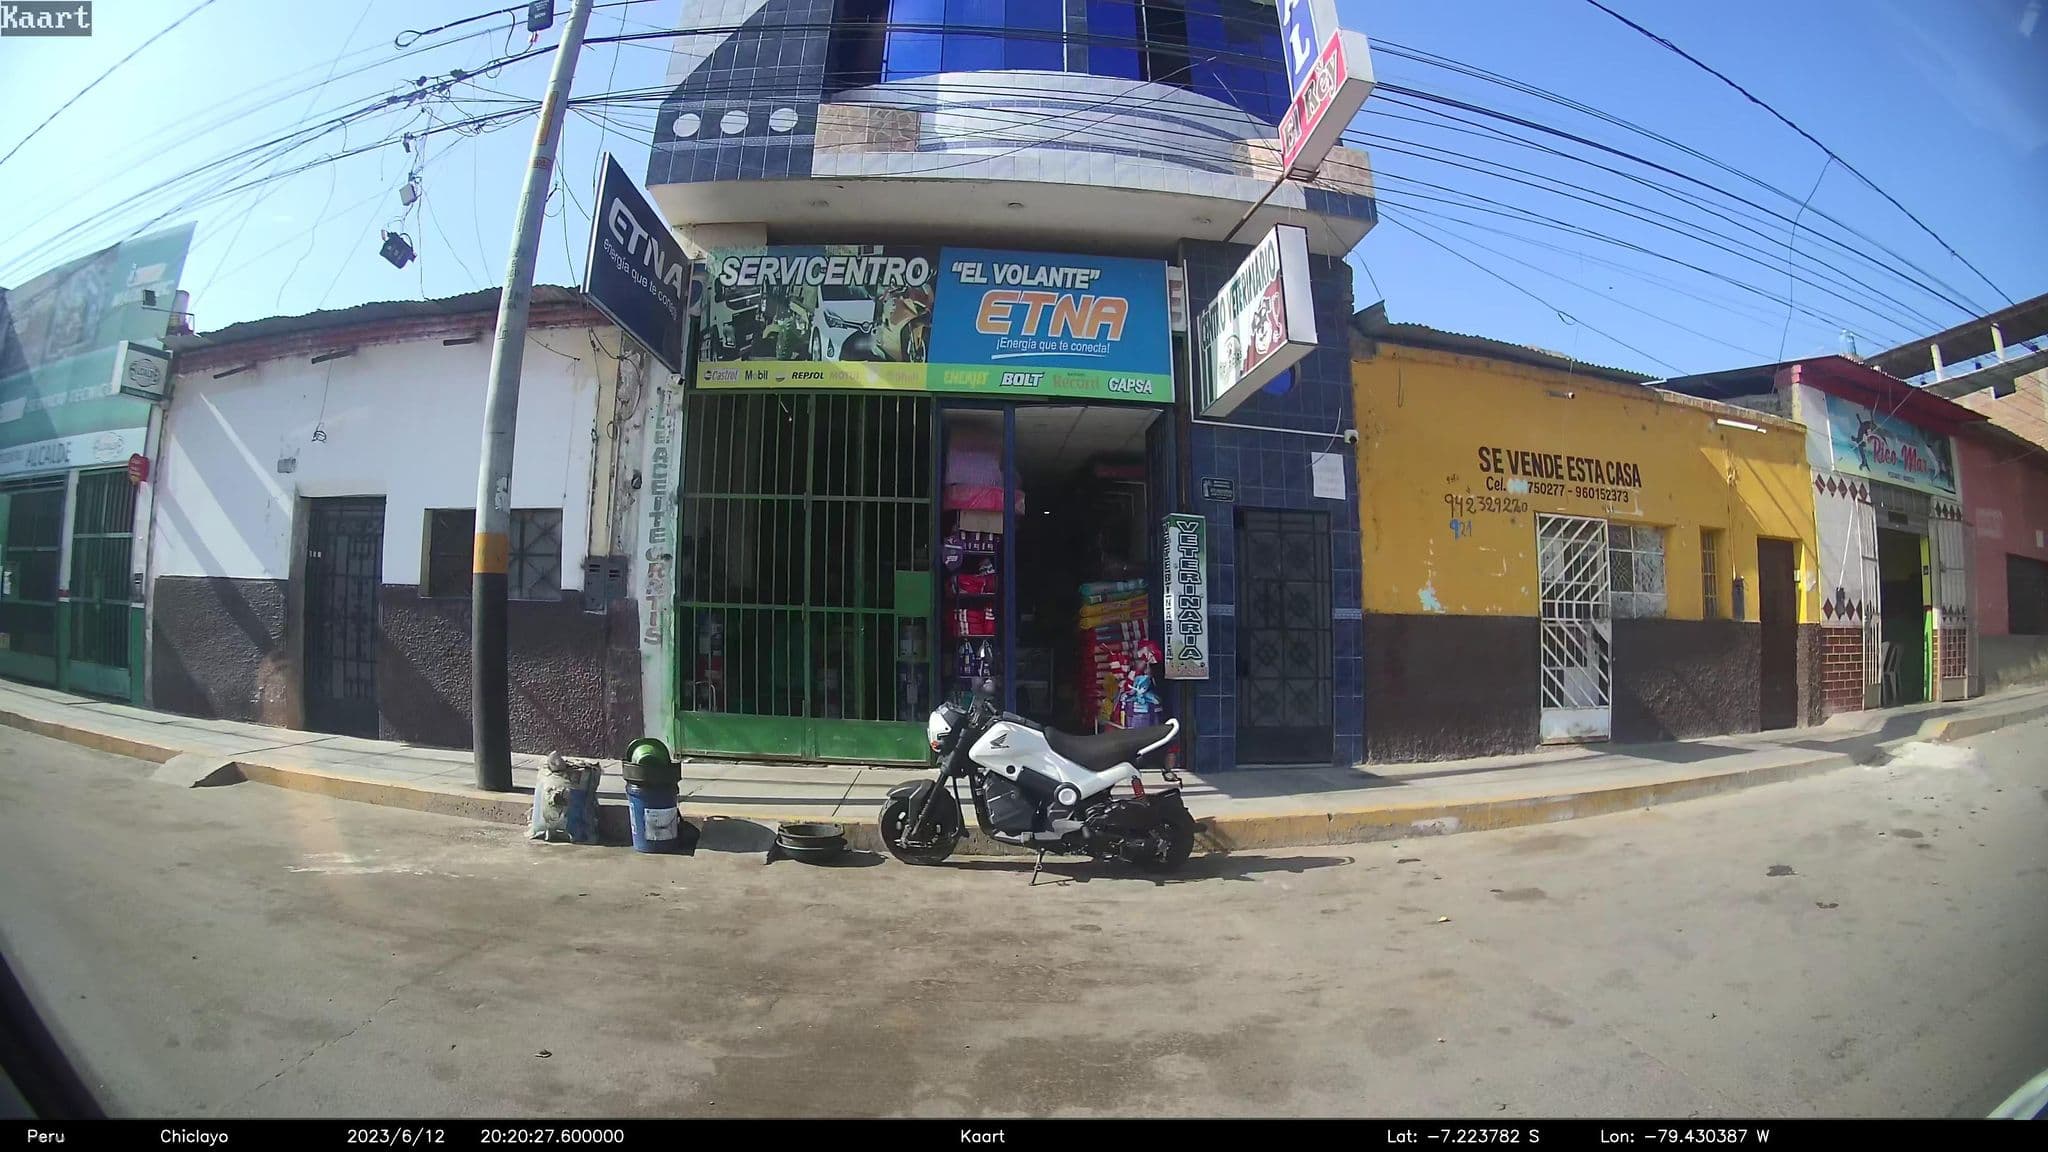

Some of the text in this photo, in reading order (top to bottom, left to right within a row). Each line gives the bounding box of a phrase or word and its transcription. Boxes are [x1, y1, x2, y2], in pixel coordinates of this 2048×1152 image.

[1284, 48, 1337, 157] El Rey
[609, 198, 683, 299] ETNA
[632, 268, 648, 287] que
[649, 281, 657, 295] te
[719, 256, 930, 287] SERVICENTRO
[1200, 296, 1226, 351] CENTRO
[1228, 239, 1276, 322] VETERINARIO
[976, 289, 1128, 341] ETNA
[1040, 340, 1057, 352] que
[1060, 340, 1069, 351] te
[1071, 342, 1110, 354] conecta!
[711, 368, 739, 381] Castrol
[791, 371, 824, 380] REPSOL
[1000, 372, 1044, 388] BOLT
[1478, 446, 1642, 488] SE VENDE ESTA CASA
[1869, 436, 1928, 473] Rico Mar
[1486, 475, 1506, 492] Cel.
[1575, 486, 1629, 503] 960152373
[1176, 521, 1203, 660] VETERINARIA
